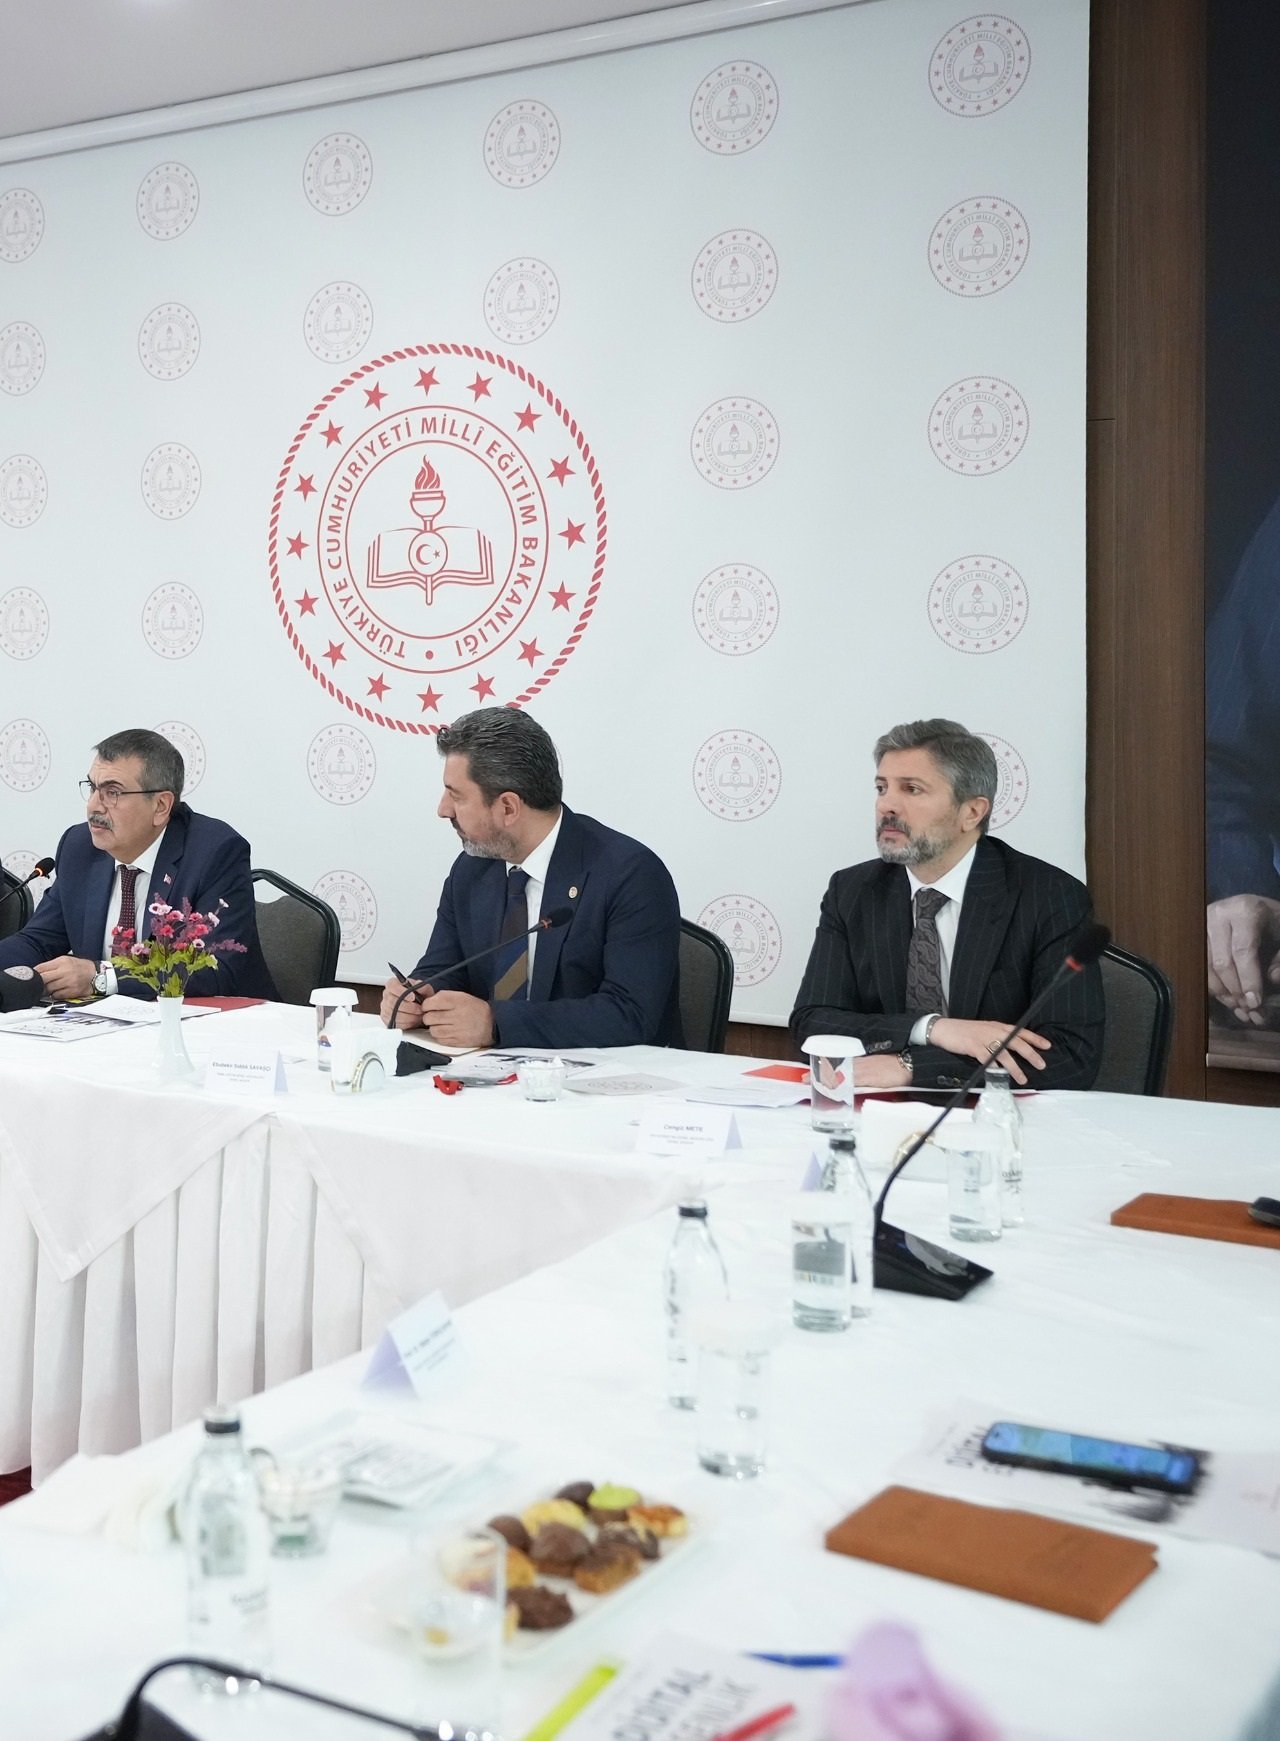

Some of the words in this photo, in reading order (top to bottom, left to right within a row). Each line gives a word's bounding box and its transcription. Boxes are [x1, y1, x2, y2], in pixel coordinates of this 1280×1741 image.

[326, 416, 412, 570] CUMHURİYETİ
[485, 440, 538, 525] EĞİTİM
[332, 577, 406, 659] TÜRKİYE
[455, 536, 539, 657] BAKANLIĞI
